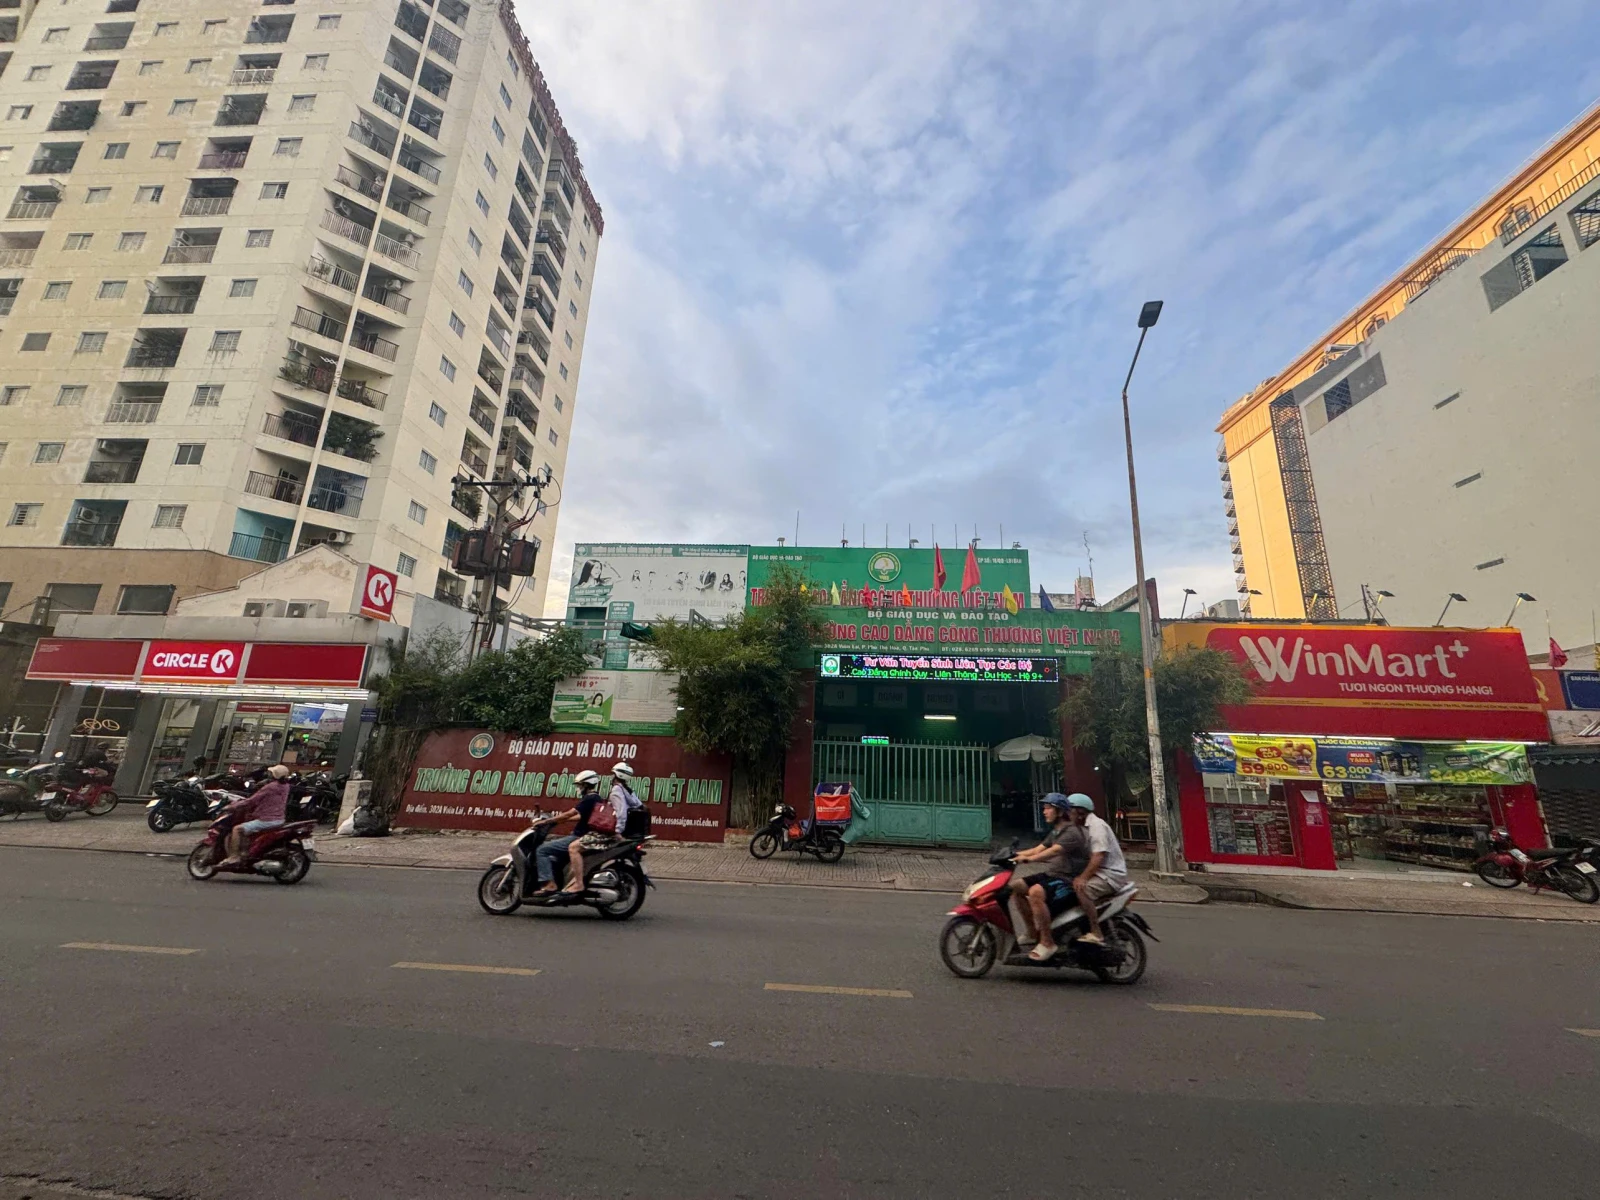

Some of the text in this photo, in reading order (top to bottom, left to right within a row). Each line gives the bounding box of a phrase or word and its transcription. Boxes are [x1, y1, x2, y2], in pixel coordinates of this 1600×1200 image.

[868, 609, 1009, 622] BỘ GIÁO DỤC VÀ ĐÀO TẠO
[862, 624, 889, 641] CAO
[894, 619, 934, 642] ĐẲNG
[939, 622, 979, 644] CÔNG
[983, 626, 1043, 645] THƯƠNG
[1046, 625, 1079, 648] VIỆT
[152, 650, 234, 673] CIRCLE K
[931, 659, 953, 669] Sinh
[955, 659, 975, 670] Liên
[977, 660, 996, 671] Tục
[997, 660, 1017, 670] Các
[1018, 660, 1032, 672] Hệ
[1239, 636, 1470, 683] WinMart+
[851, 668, 867, 676] Cao
[913, 670, 928, 679] Quy
[935, 670, 952, 678] Liên
[953, 670, 978, 680] Thông
[984, 671, 996, 679] Du
[997, 671, 1012, 681] Học
[1019, 672, 1031, 682] Hệ
[1369, 683, 1402, 693] NGON
[1457, 685, 1494, 697] HẠNG!
[508, 737, 523, 757] BỘ
[524, 738, 551, 756] GIÁO
[552, 741, 573, 759] DỤC
[576, 740, 589, 758] VÀ
[592, 740, 614, 758] ĐÀO
[617, 744, 637, 761] TẠO
[414, 762, 471, 794] TRƯỜNG
[470, 770, 502, 795] CAO
[502, 760, 545, 797] ĐẲNG
[546, 768, 583, 798] CÔN
[653, 772, 686, 808] VIỆT
[686, 779, 723, 805] NAM
[406, 804, 415, 813] Địa
[467, 807, 473, 815] P.
[507, 808, 514, 818] Q.
[651, 815, 664, 825] Web:
